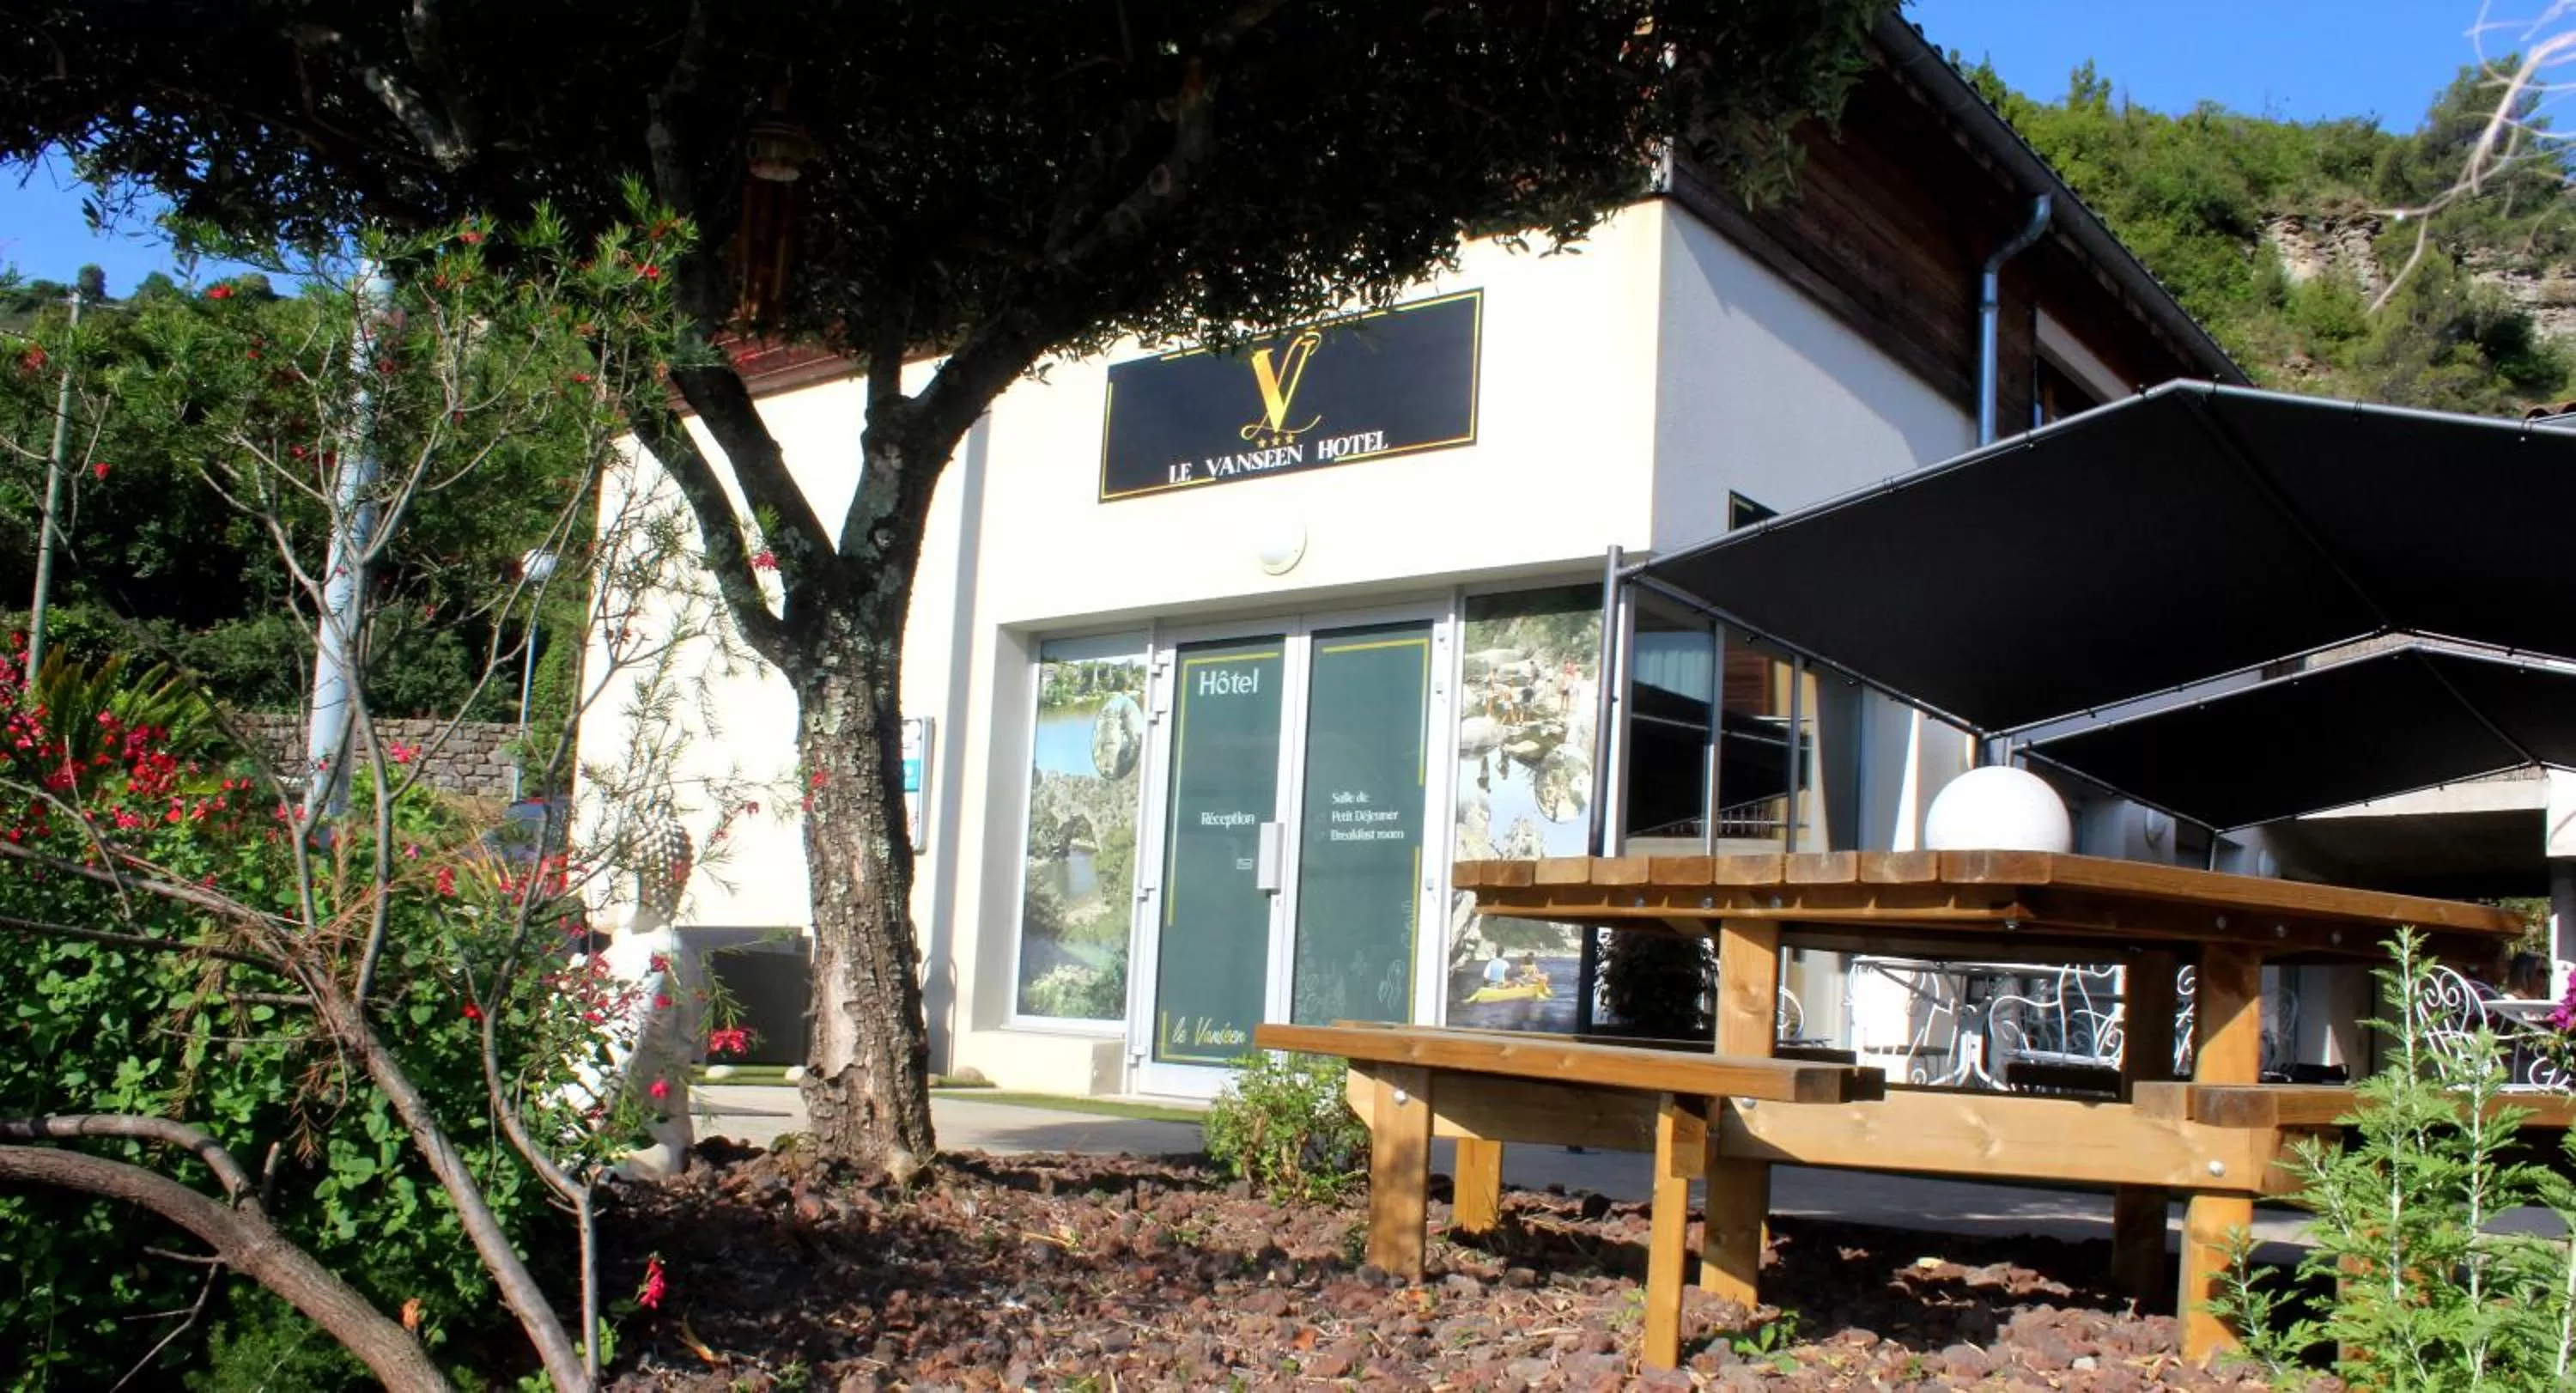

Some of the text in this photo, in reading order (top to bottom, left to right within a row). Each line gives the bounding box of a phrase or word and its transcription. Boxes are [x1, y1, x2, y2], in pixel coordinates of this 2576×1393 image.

[1169, 430, 1388, 484] LE VANSEEN HOTEL
[1199, 667, 1260, 696] Hôtel
[1201, 811, 1255, 830] Réception
